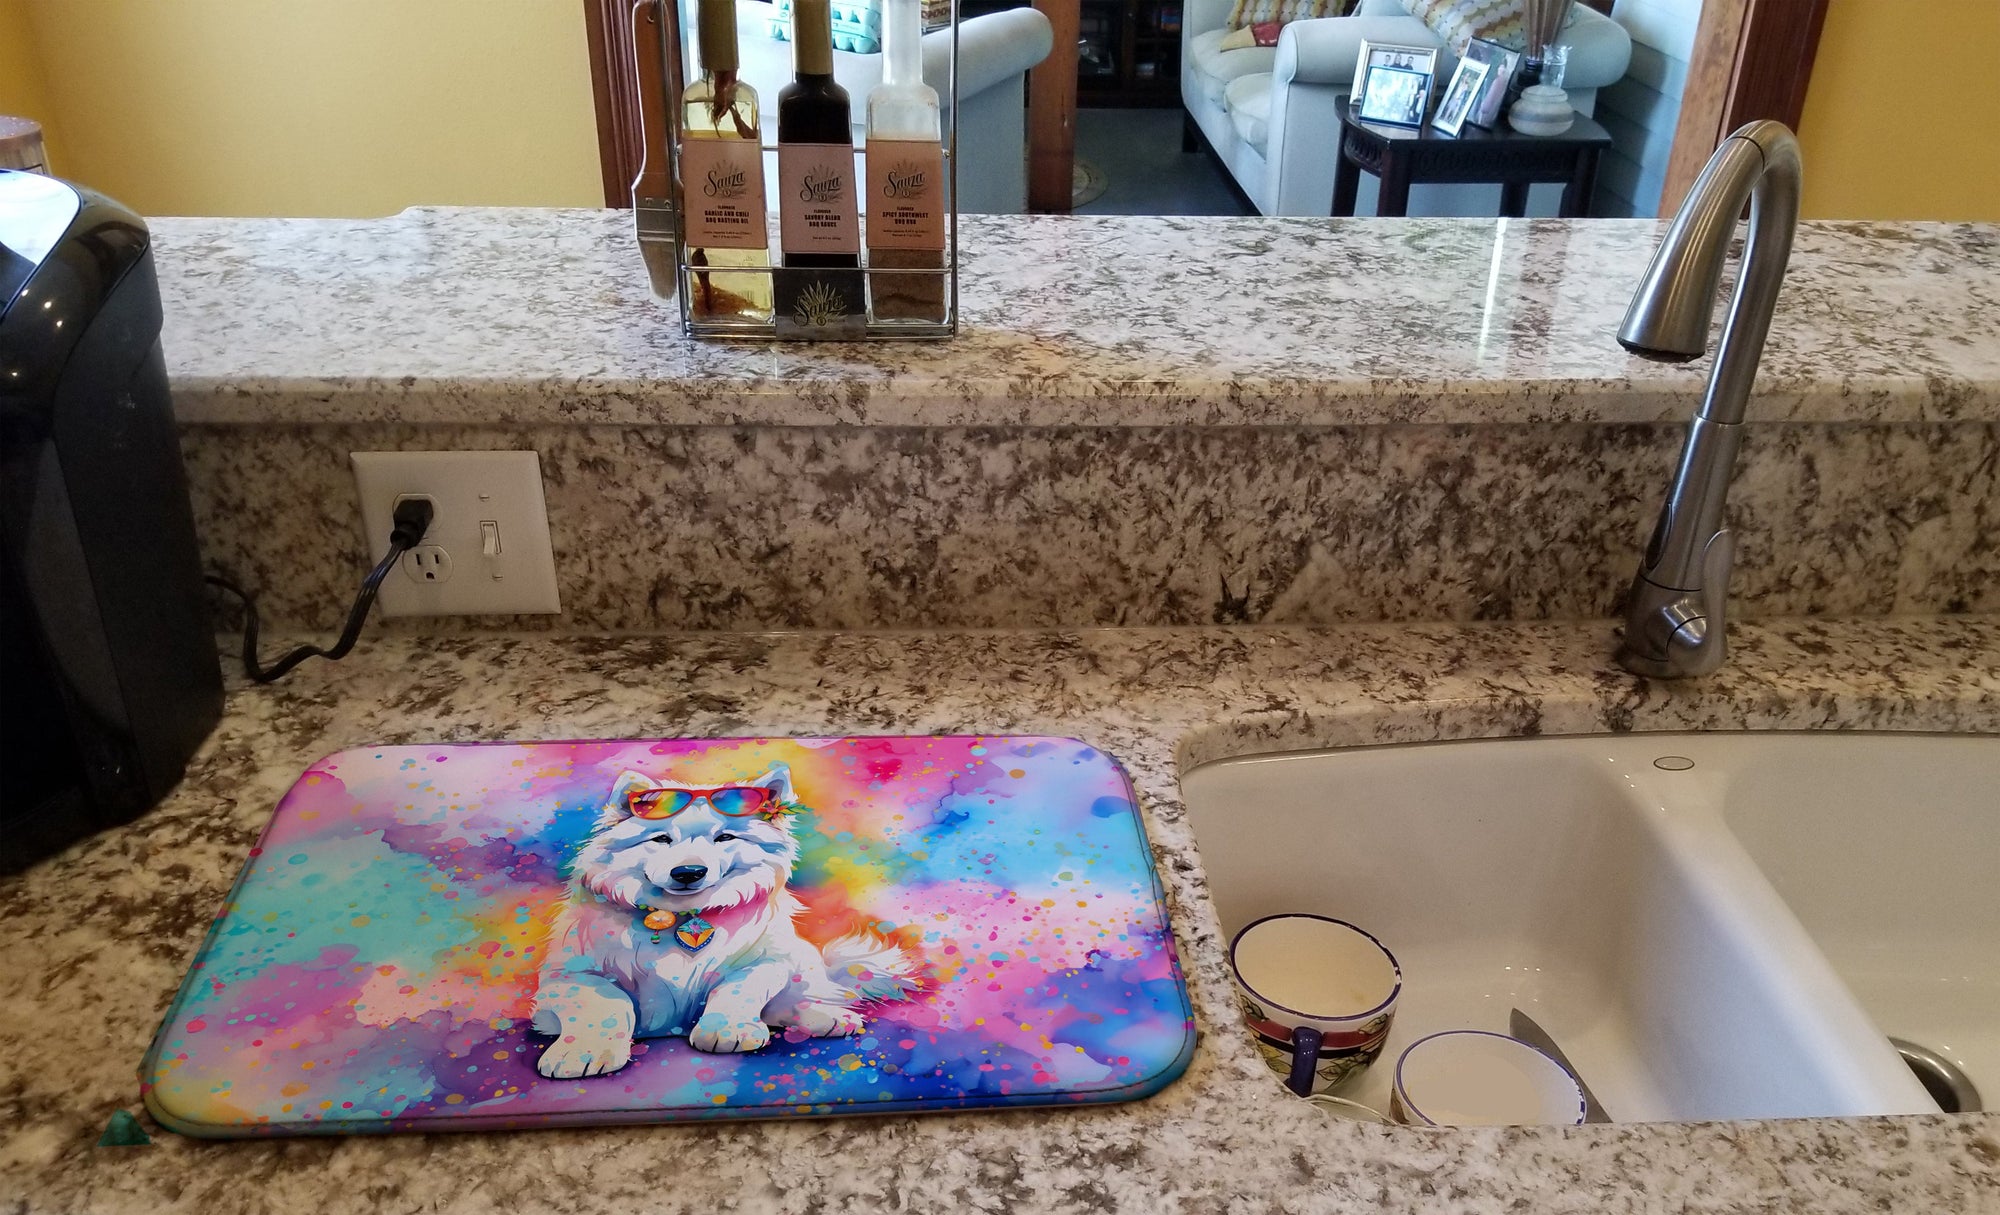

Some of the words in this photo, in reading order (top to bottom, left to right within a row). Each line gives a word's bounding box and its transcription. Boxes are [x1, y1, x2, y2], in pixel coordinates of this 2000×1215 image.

[703, 168, 746, 197] Sauza
[799, 175, 842, 202] Sauza
[884, 171, 925, 198] Sauza
